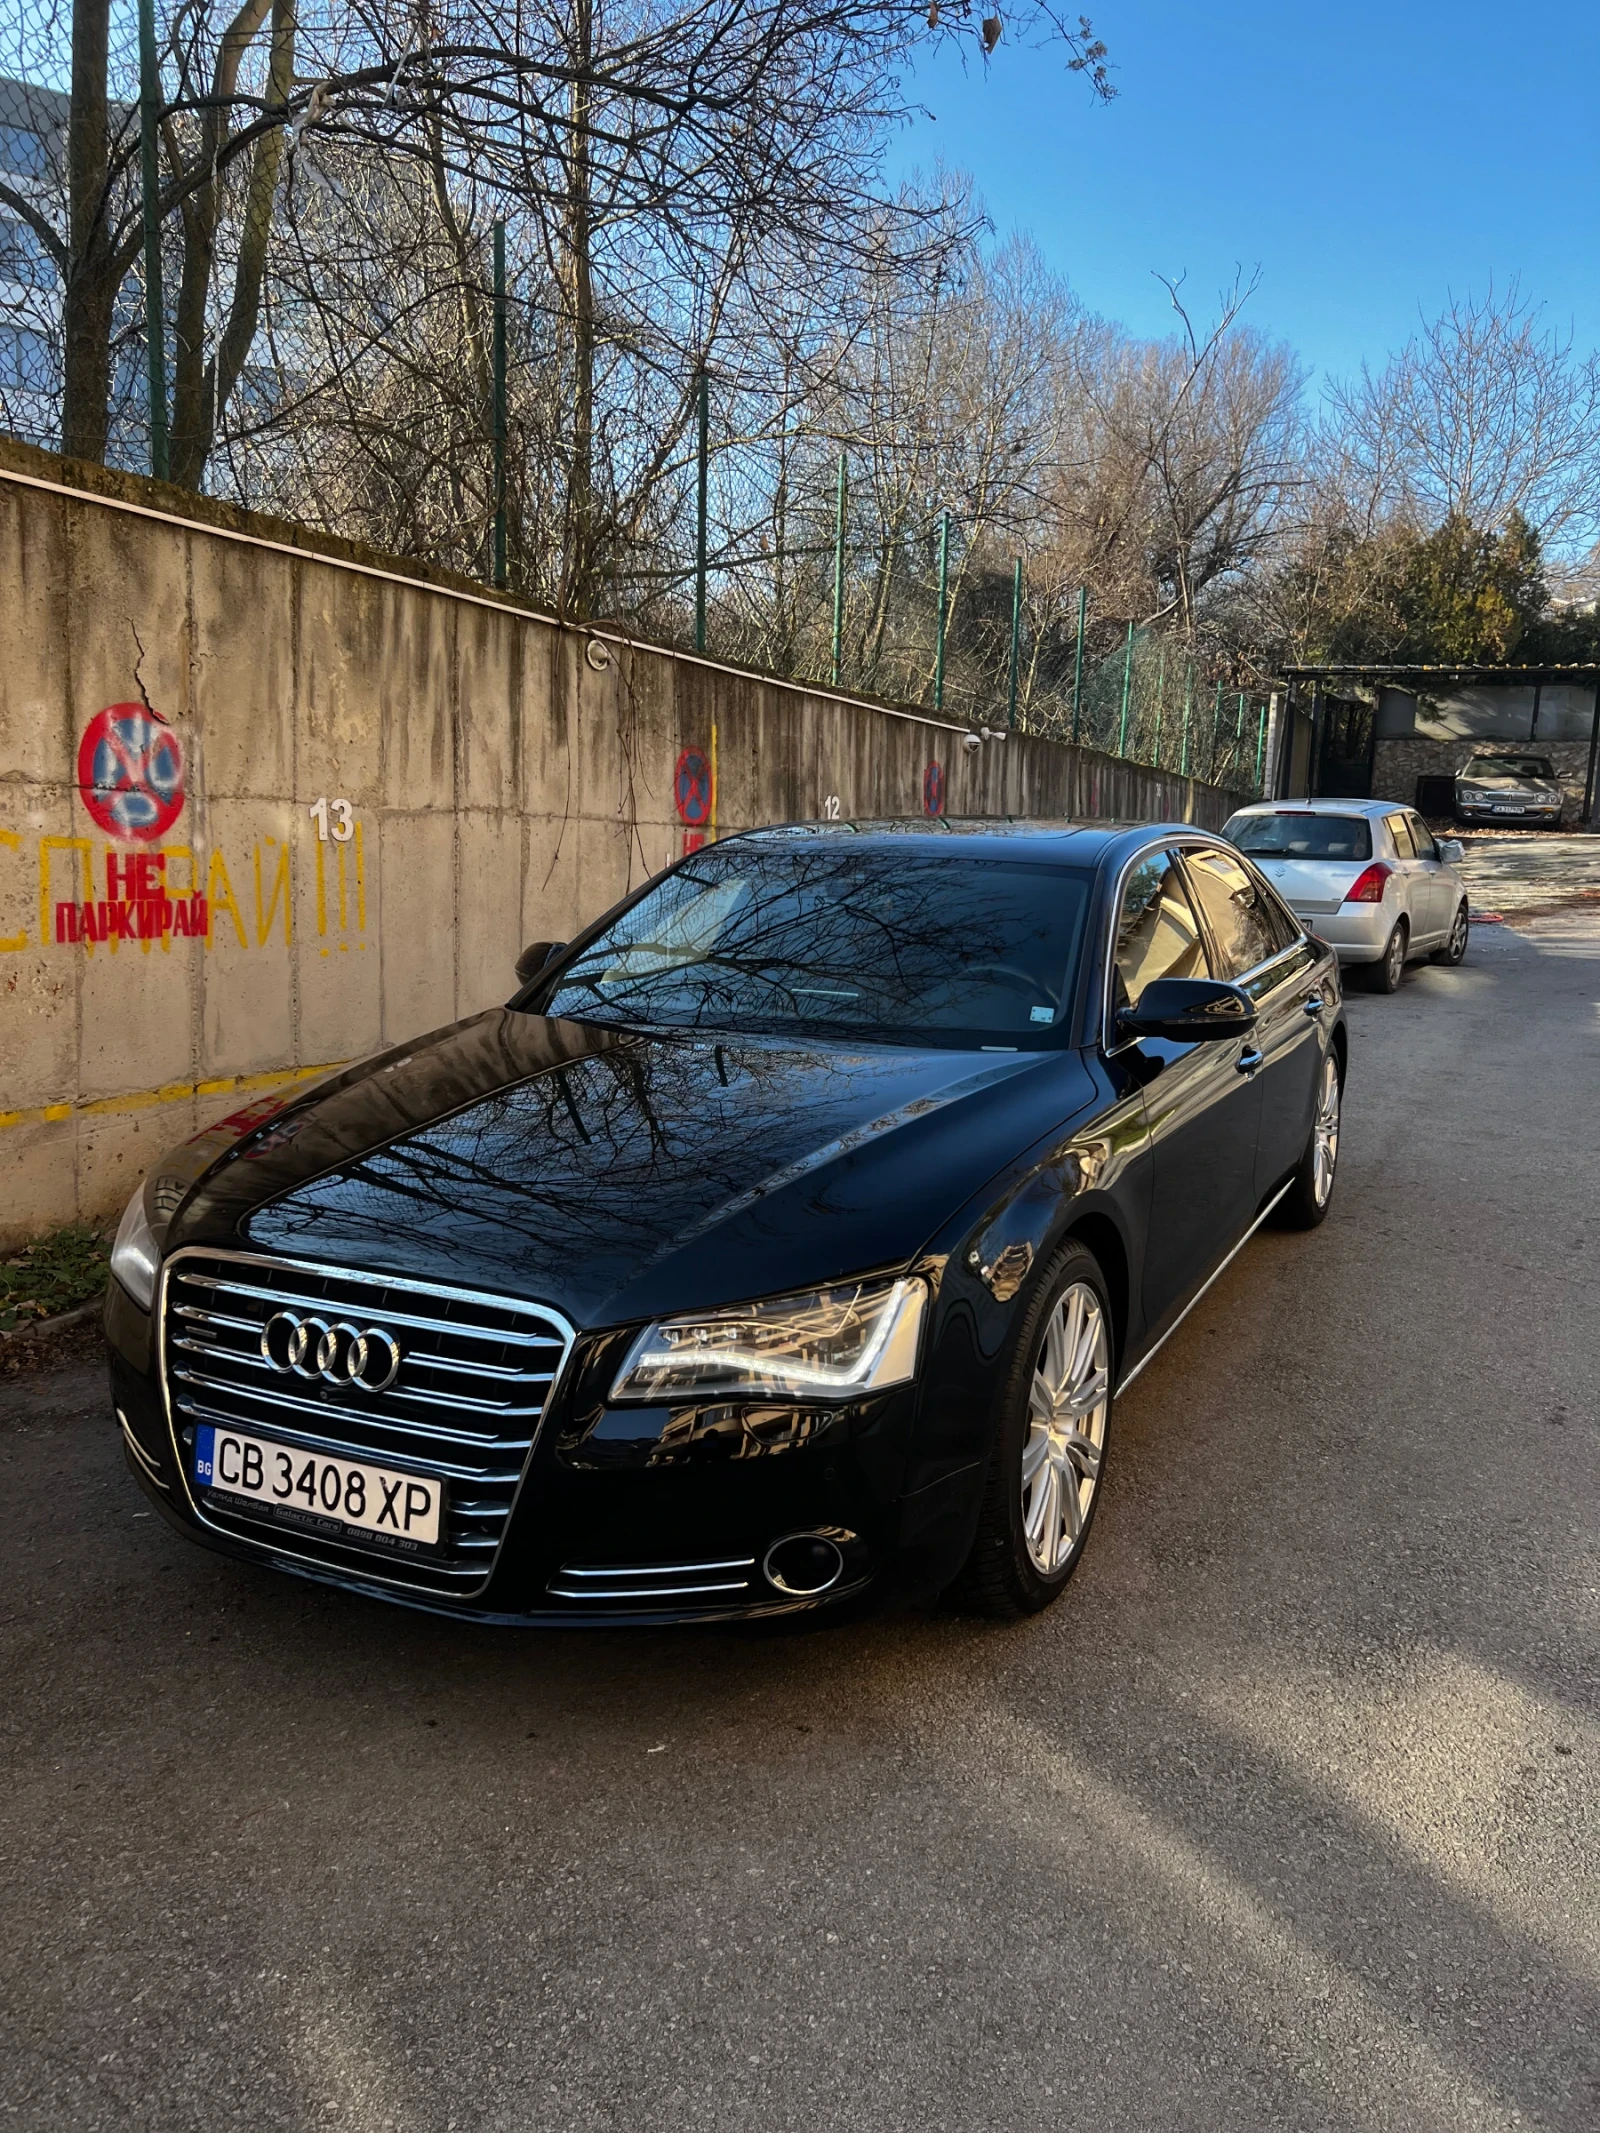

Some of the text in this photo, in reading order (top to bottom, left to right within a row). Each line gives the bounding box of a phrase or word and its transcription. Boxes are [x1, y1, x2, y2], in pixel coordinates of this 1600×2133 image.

[309, 797, 354, 842] 13
[825, 795, 840, 820] 12
[107, 852, 166, 901] НЕ
[56, 890, 208, 944] ПАРКИРАЙ
[197, 1459, 212, 1476] BG
[272, 1451, 367, 1519] 3408
[275, 1507, 315, 1523] Galactic
